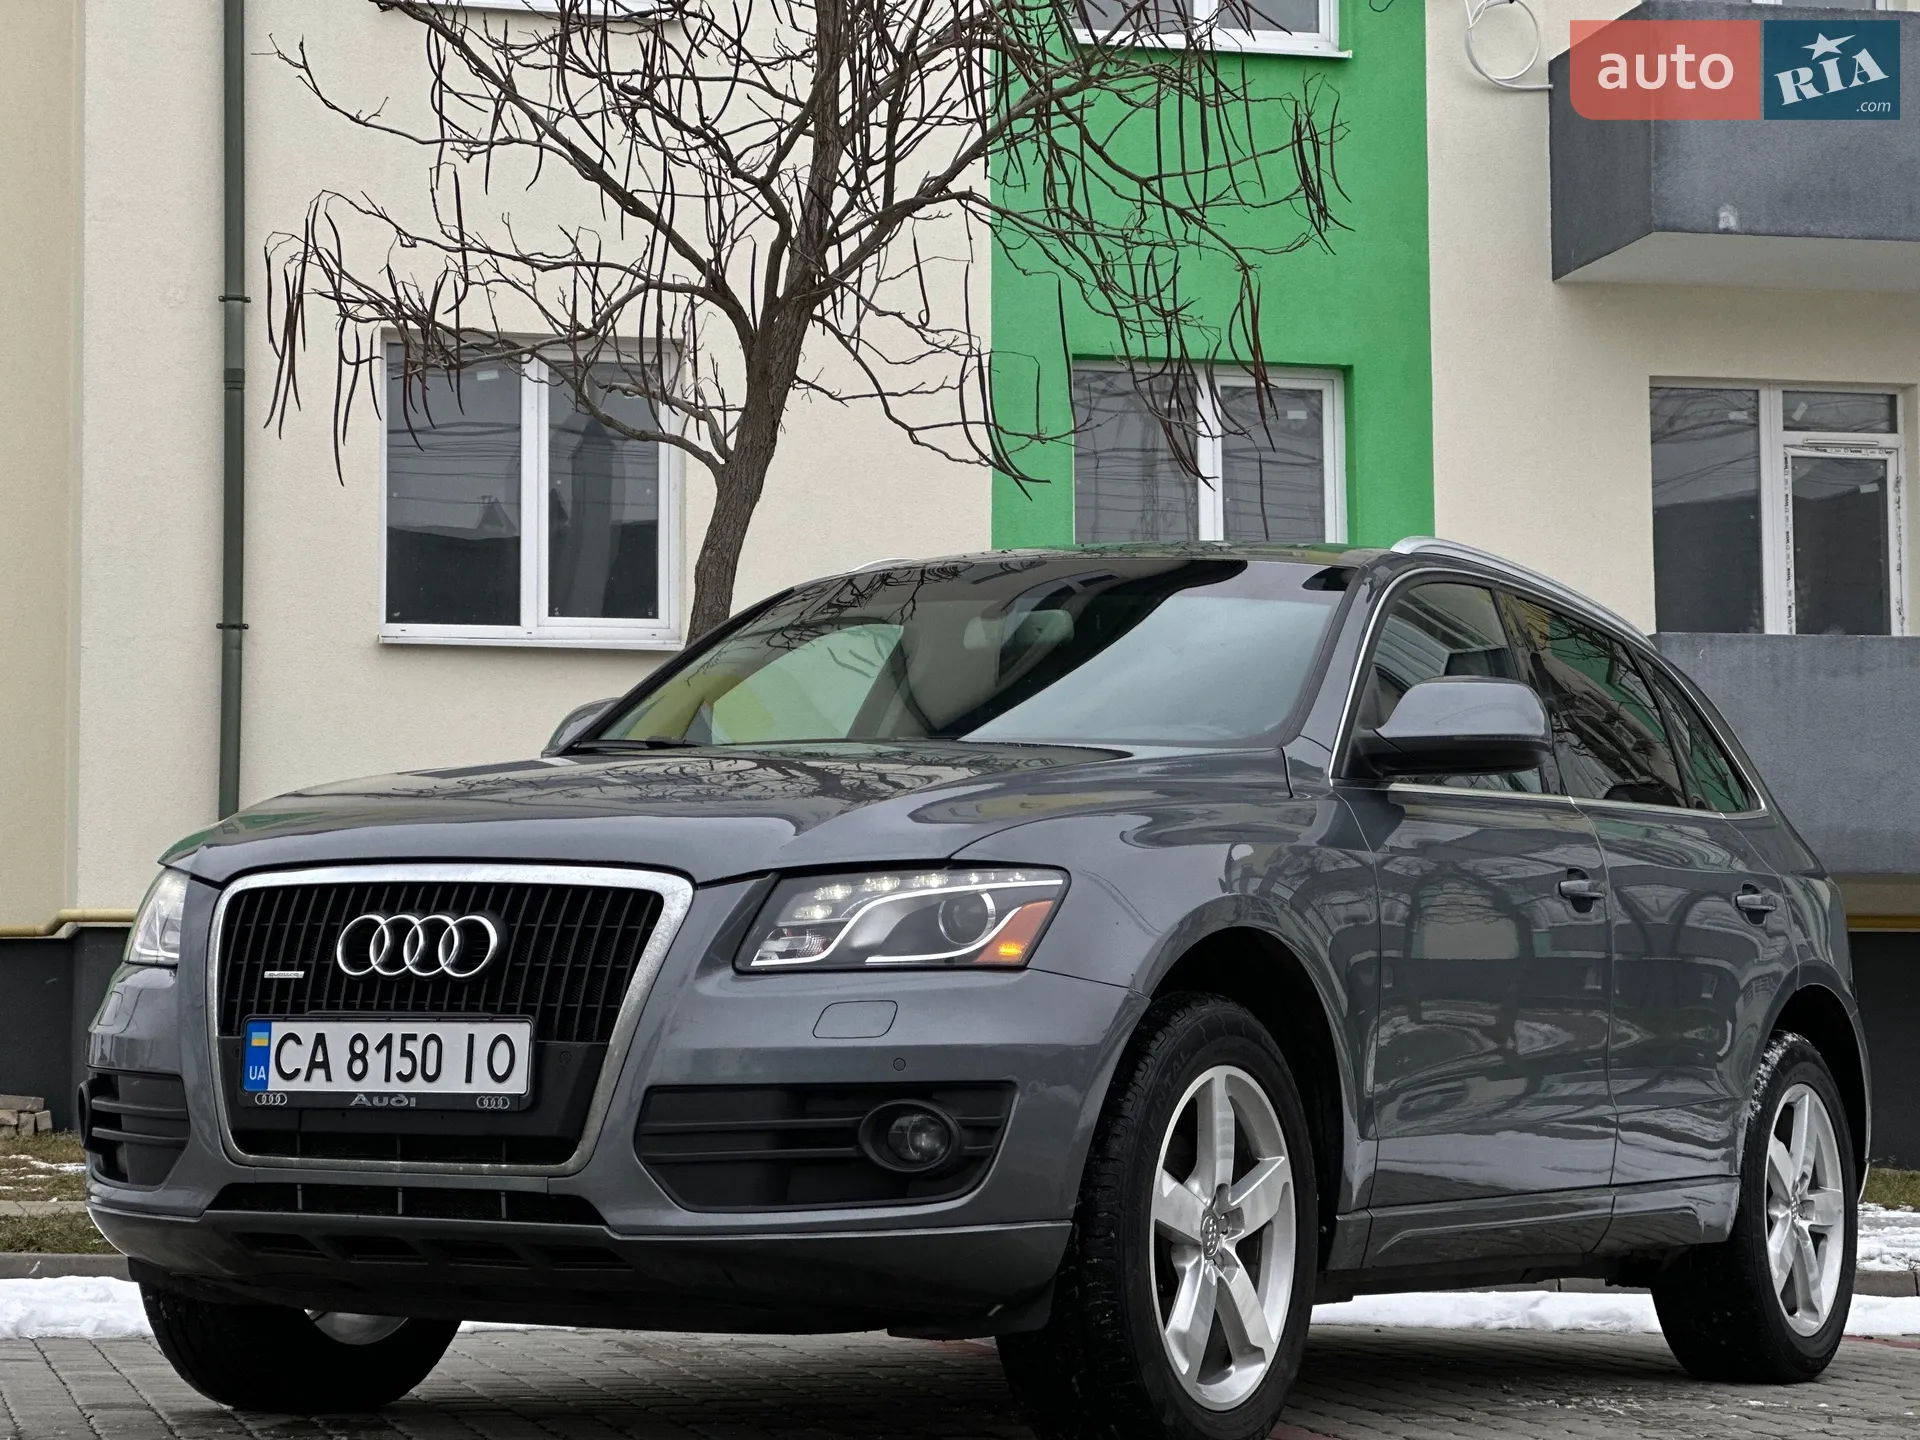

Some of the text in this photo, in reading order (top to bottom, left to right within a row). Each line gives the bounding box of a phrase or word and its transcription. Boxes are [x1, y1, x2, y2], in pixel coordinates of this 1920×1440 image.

[274, 1032, 516, 1084] CA 8150 IO
[249, 1065, 266, 1081] UA
[350, 1094, 416, 1107] Audi
